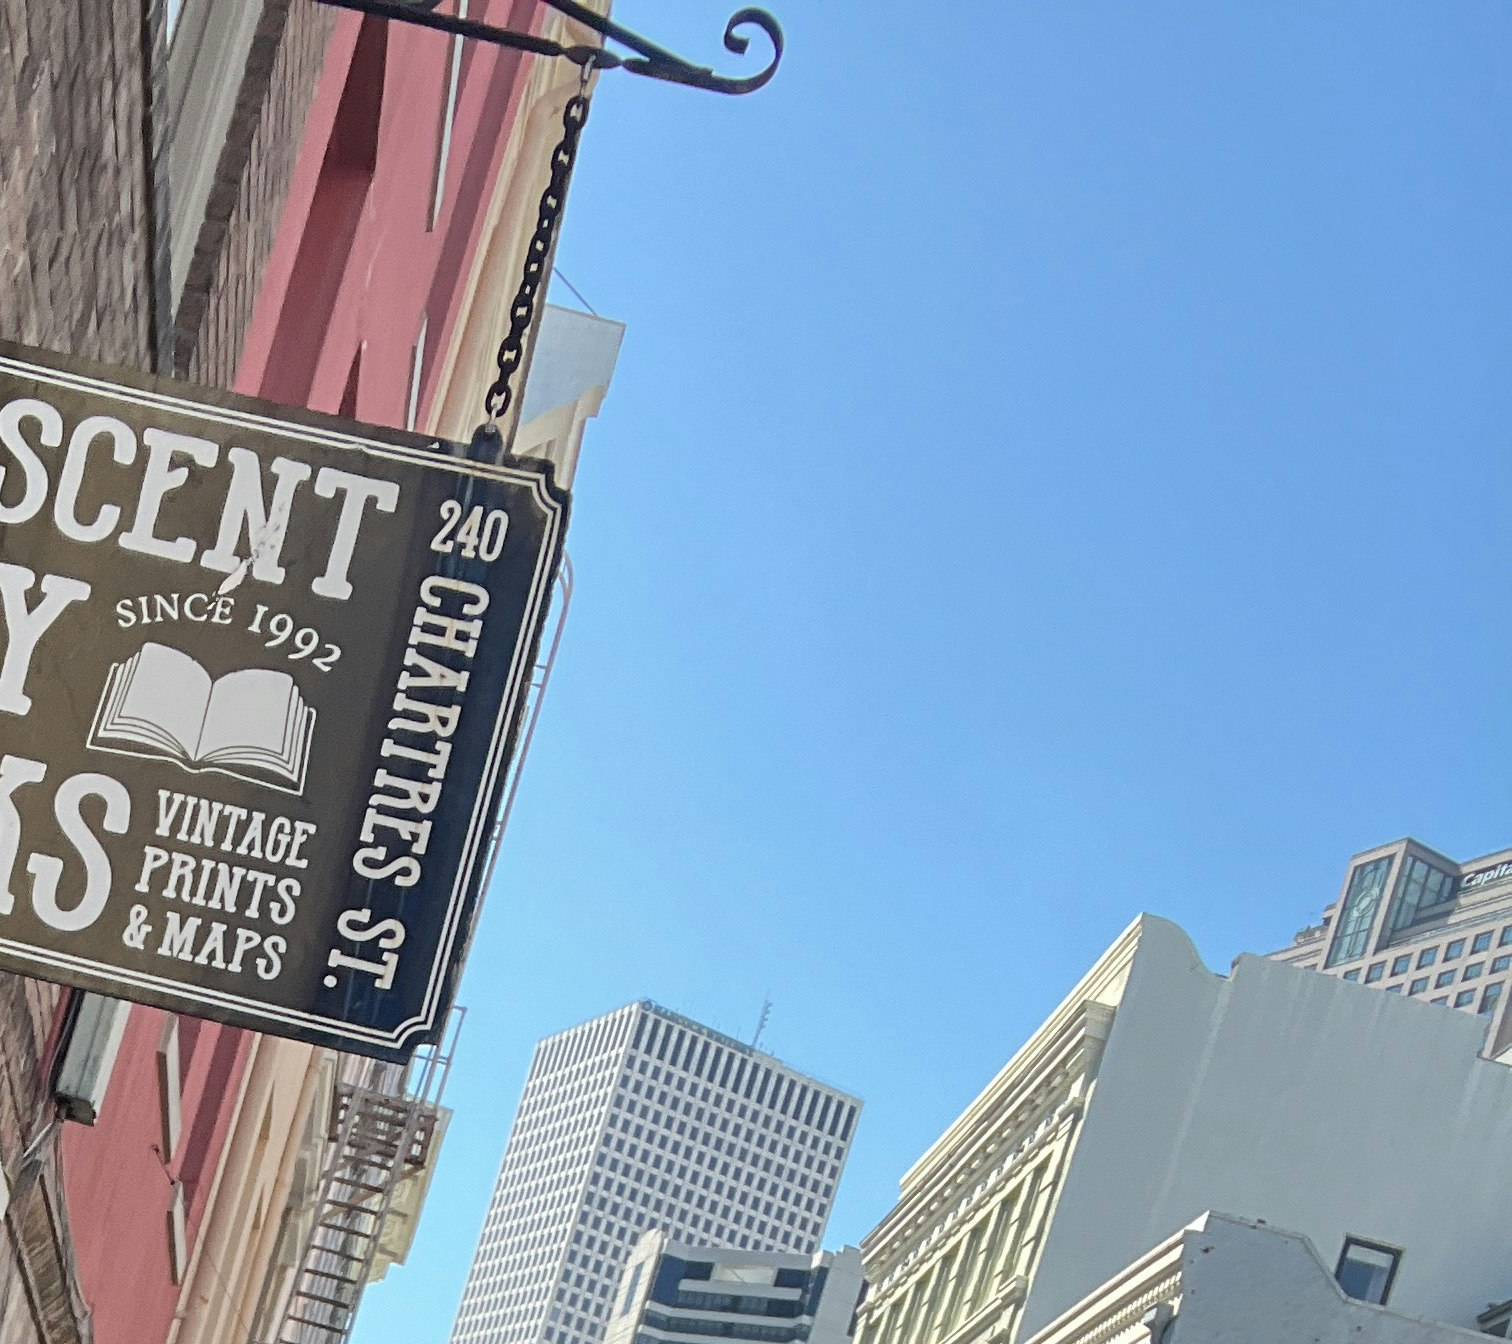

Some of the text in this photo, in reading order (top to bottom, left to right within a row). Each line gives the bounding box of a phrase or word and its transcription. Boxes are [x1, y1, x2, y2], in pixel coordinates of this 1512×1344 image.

[431, 499, 509, 562] 240
[115, 592, 342, 672] SINCE 1992
[322, 574, 491, 991] CHARTRES ST.
[155, 789, 317, 869] VINTAGE
[134, 845, 301, 925] PRINTS
[122, 904, 287, 981] & MAPS
